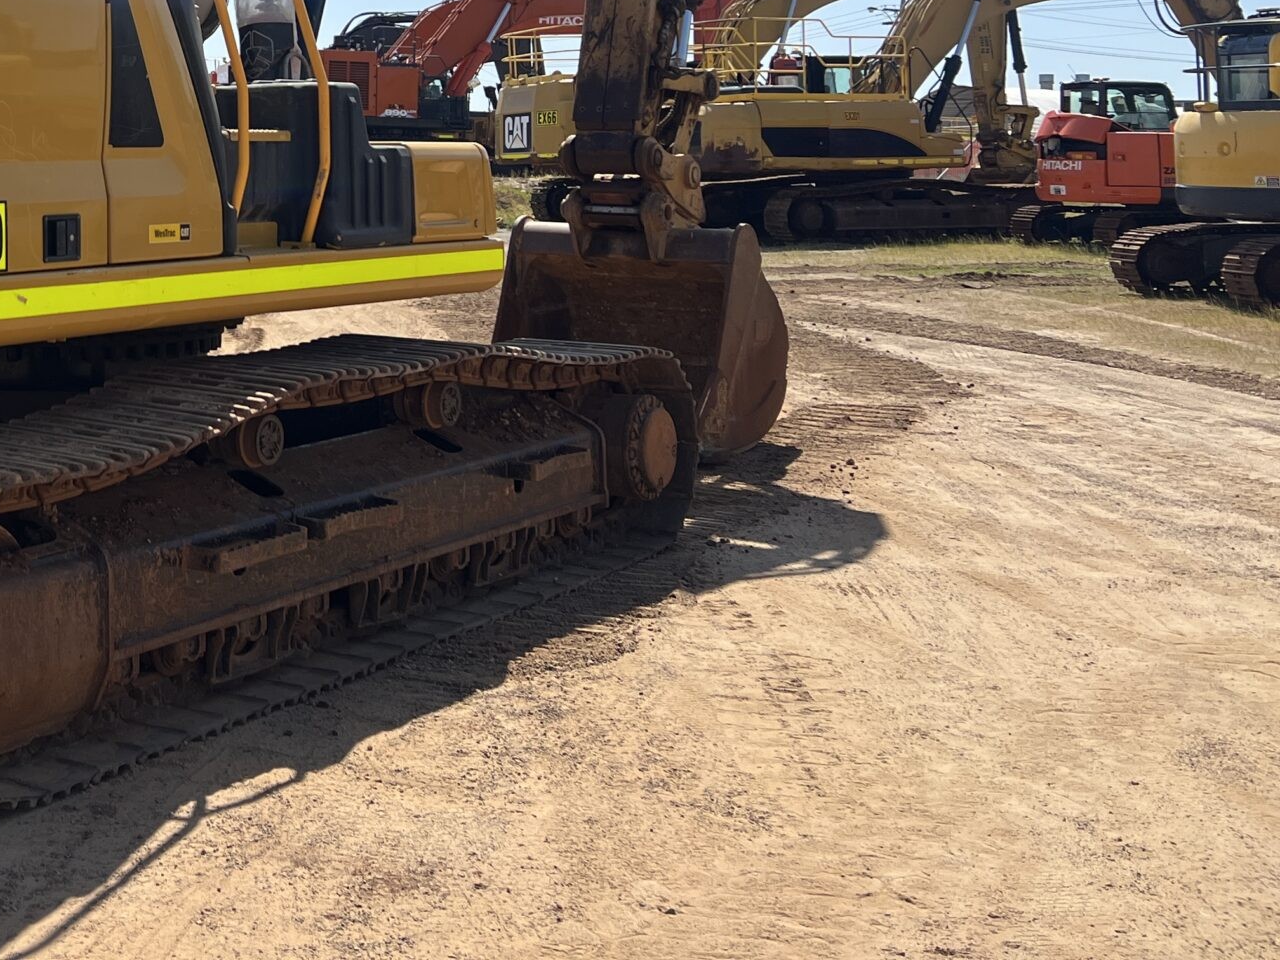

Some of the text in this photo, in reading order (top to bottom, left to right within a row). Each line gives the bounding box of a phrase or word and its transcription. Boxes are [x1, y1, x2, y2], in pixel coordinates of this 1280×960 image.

[538, 15, 584, 26] HITAC
[537, 111, 557, 125] EX66
[504, 115, 530, 150] CAT
[1042, 160, 1082, 171] HITACHI
[1163, 167, 1176, 175] ZA
